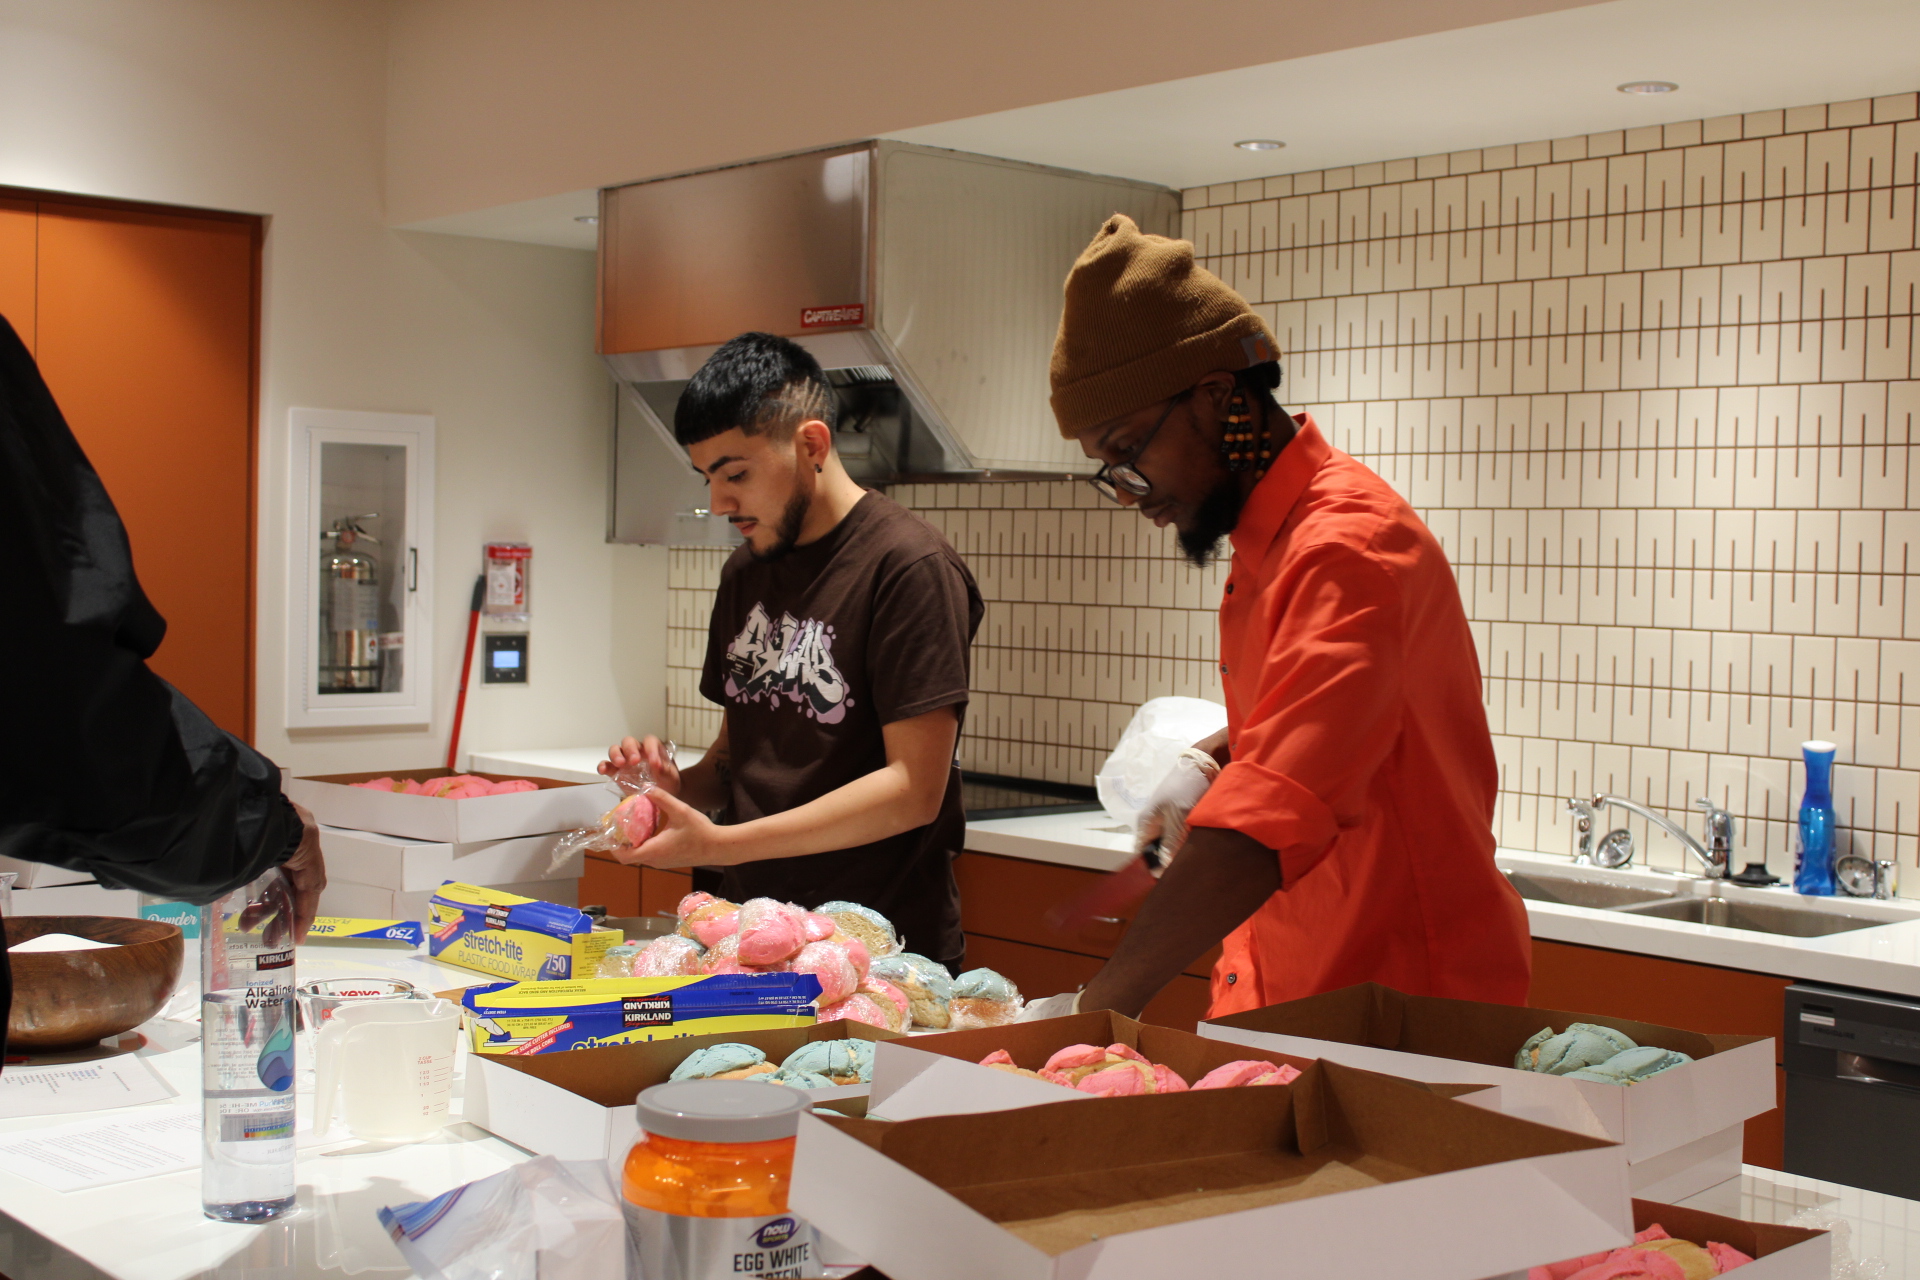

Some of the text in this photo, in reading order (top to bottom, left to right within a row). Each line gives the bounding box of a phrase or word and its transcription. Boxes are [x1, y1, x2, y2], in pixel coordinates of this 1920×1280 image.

[386, 928, 414, 940] 750
[464, 929, 523, 962] stretch-tite
[458, 950, 537, 982] PLASTIC FOOD WRAP
[546, 953, 566, 974] 750
[246, 985, 292, 998] Alkaline
[246, 998, 284, 1009] Water
[624, 1001, 670, 1010] KIRKLAND
[625, 1012, 672, 1022] KIRKLAND
[520, 1041, 532, 1052] SLIDE
[532, 1032, 548, 1044] CUTTER
[548, 1022, 570, 1035] INCLUDED
[763, 1222, 790, 1236] now
[734, 1243, 809, 1272] EGG WHITE
